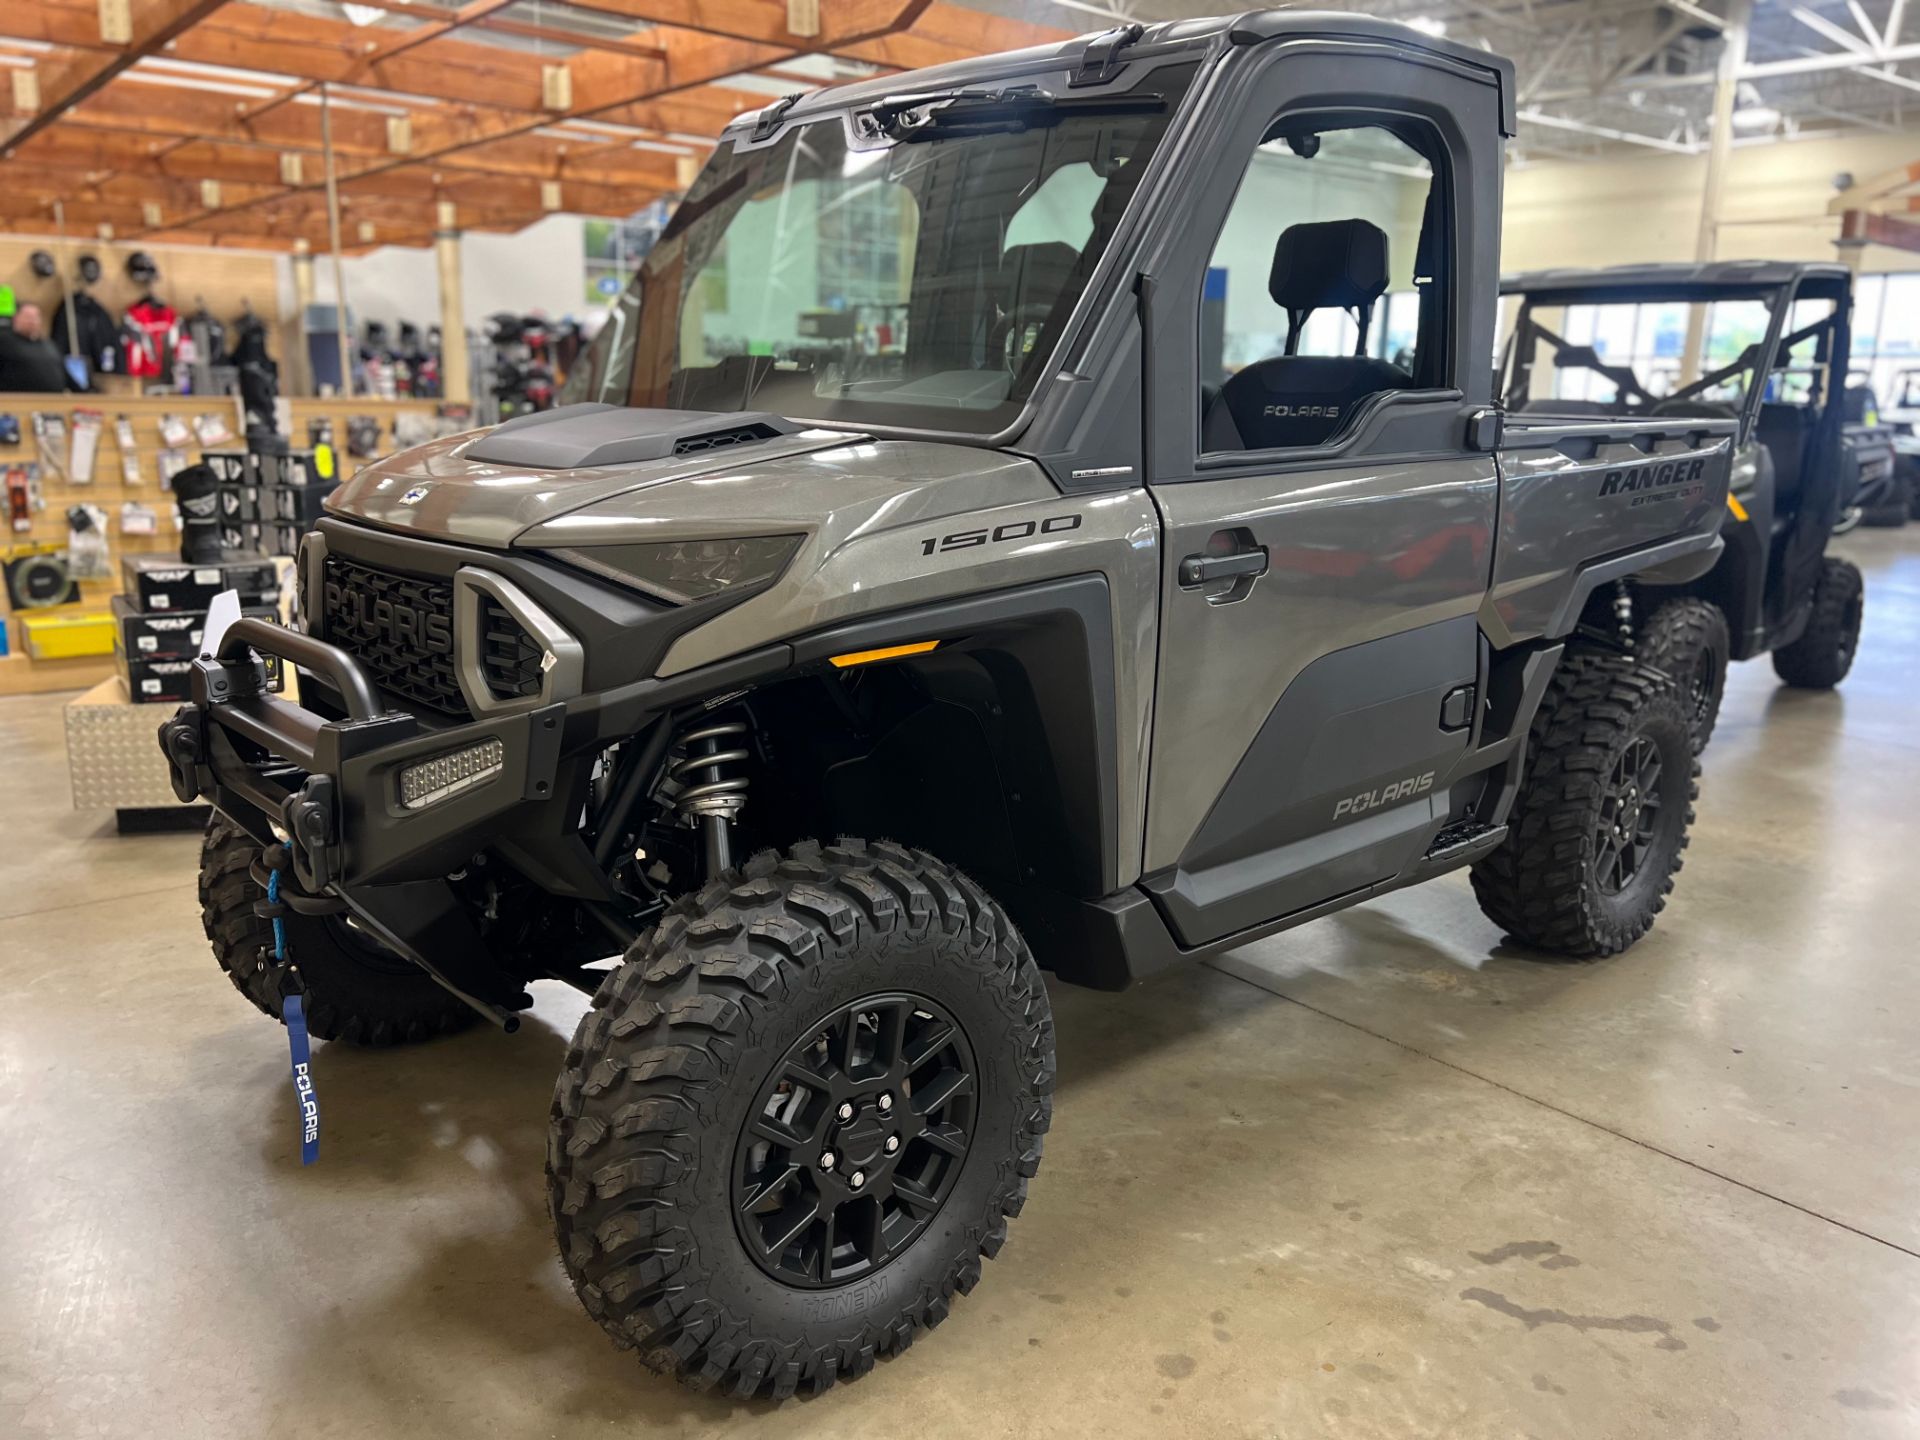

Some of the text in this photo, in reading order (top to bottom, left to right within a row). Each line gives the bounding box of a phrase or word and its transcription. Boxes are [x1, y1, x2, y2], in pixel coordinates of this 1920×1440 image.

[1263, 405, 1340, 418] POLARIS
[1598, 459, 1705, 497] RANGER
[921, 513, 1082, 556] 1500
[325, 581, 452, 654] POLARIS
[1332, 770, 1436, 821] POLARIS
[294, 1062, 318, 1144] POLARIS
